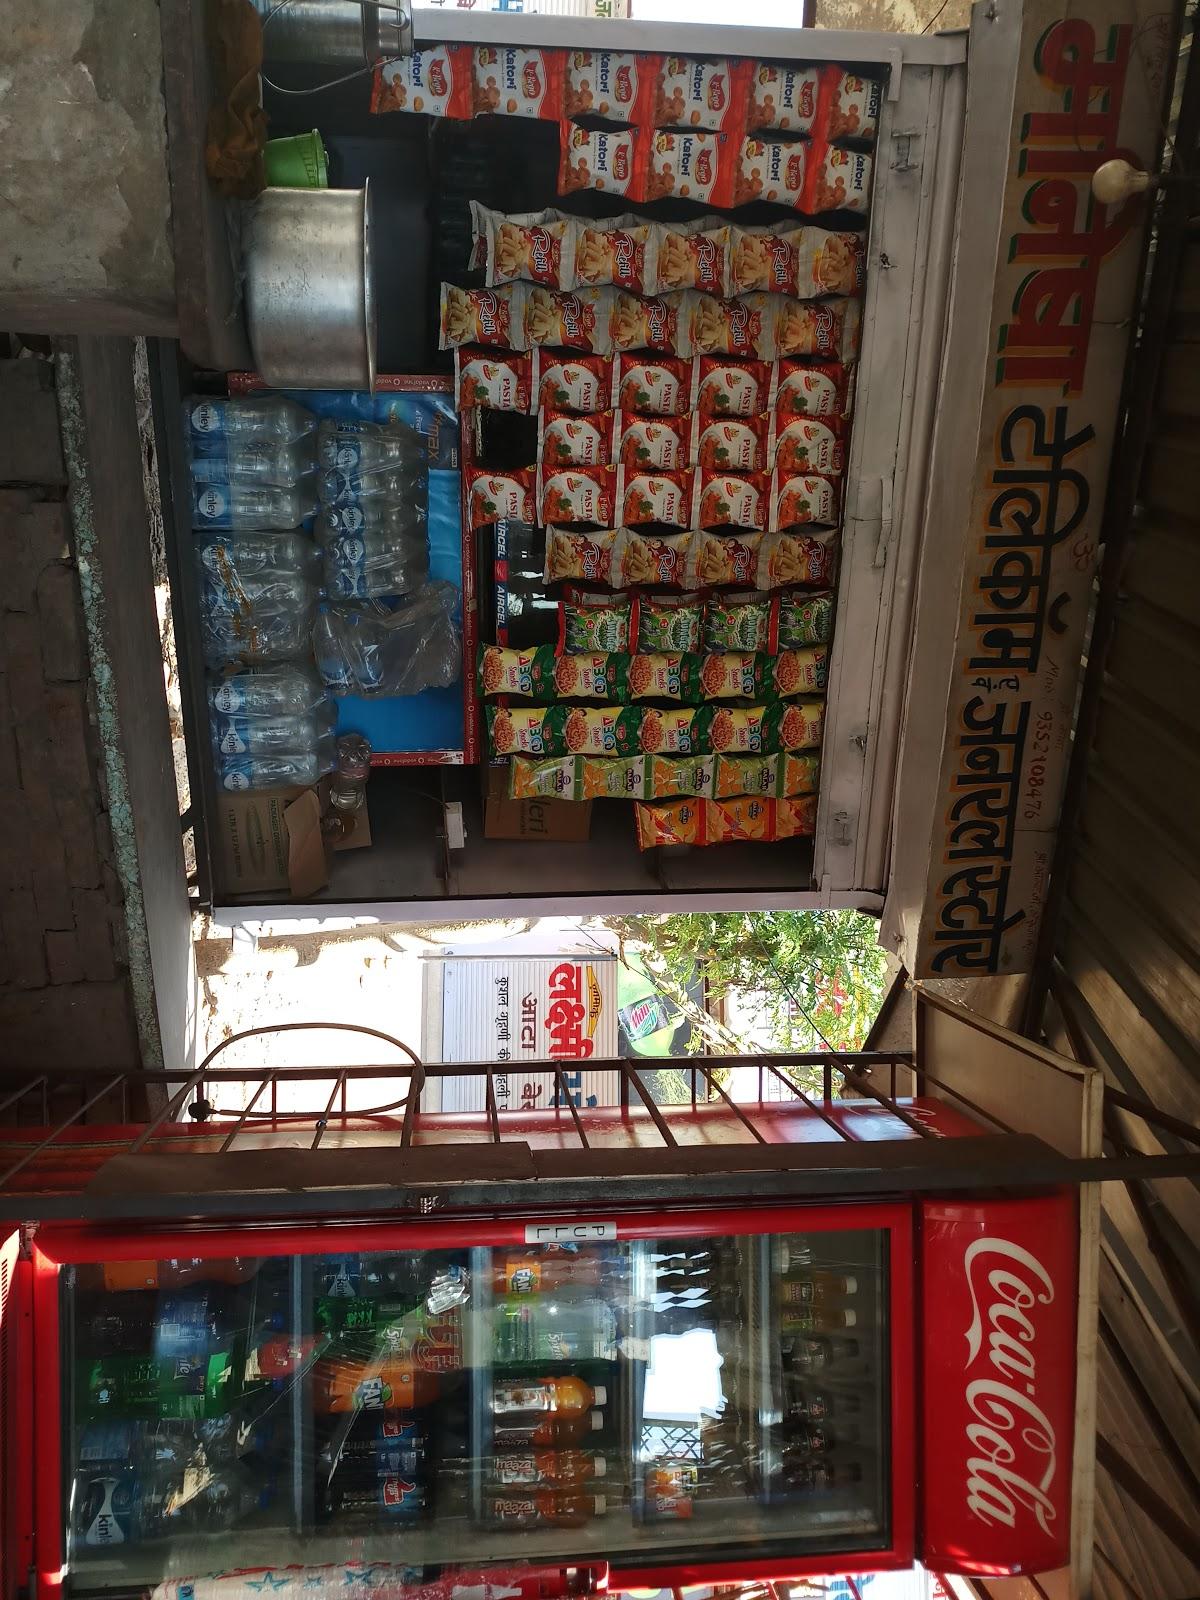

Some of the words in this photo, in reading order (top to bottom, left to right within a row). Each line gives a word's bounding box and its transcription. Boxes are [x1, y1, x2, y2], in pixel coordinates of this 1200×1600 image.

[505, 49, 516, 90] Katori
[599, 53, 610, 94] Katori
[597, 133, 608, 172] Katori
[681, 138, 693, 176] Katori
[771, 145, 782, 182] Katori
[531, 229, 552, 274] Refill
[614, 234, 634, 278] Refill
[697, 238, 715, 283] Refill
[772, 240, 791, 285] Refill
[477, 292, 498, 336] Refill
[561, 294, 581, 338] Refill
[648, 297, 667, 343] Refill
[730, 302, 748, 347] Refill
[814, 307, 833, 350] Refill
[500, 378, 511, 408] PASTA
[581, 382, 592, 412] PASTA
[662, 384, 673, 413] PASTA
[819, 390, 830, 415] PAST
[198, 404, 210, 432] kinley
[582, 436, 593, 464] PASTA
[662, 440, 673, 469] PASTA
[741, 439, 751, 468] PASTA
[819, 438, 829, 468] PASTA
[583, 488, 593, 518] PASTA
[664, 492, 675, 521] PASTA
[741, 494, 753, 523] PASTA
[819, 490, 829, 519] PASTA
[964, 404, 1096, 676] टेलिकॉम
[496, 584, 506, 626] AIRCEL
[518, 656, 532, 692] ABCD
[592, 656, 606, 694] ABCD
[667, 658, 681, 695] ABCD
[740, 656, 754, 694] ABCD
[814, 654, 827, 688] ABCD
[527, 718, 543, 752] ABCD
[601, 717, 616, 751] ABCD
[676, 719, 690, 752] ABCD
[746, 717, 761, 751] ABCD
[948, 695, 1032, 861] जनरल
[1022, 711, 1053, 820] 9352108476
[931, 866, 1026, 974] स्टोर
[494, 976, 510, 1007] कुशल
[494, 1011, 512, 1041] गृहणी
[521, 992, 538, 1053] आटा
[536, 1225, 606, 1240] PULL
[964, 1237, 1058, 1539] Coca-Cola
[494, 1499, 536, 1514] maaza
